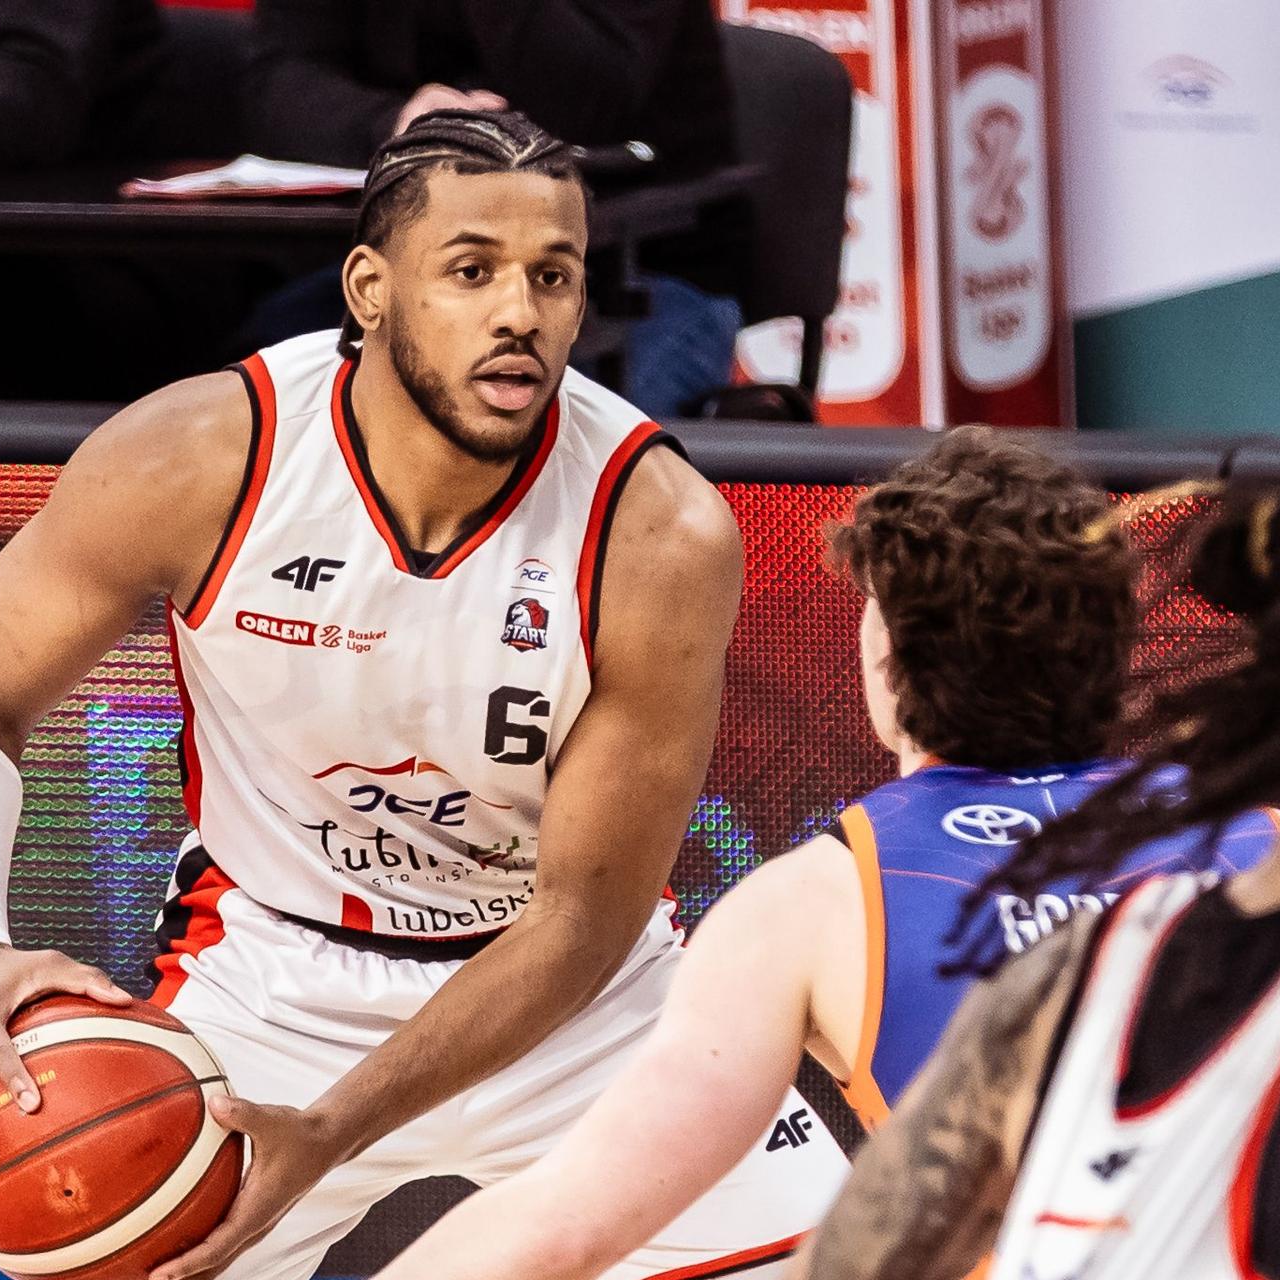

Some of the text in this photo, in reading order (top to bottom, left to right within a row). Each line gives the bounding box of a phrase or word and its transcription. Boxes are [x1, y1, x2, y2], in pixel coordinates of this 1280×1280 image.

[271, 555, 346, 592] 4F
[520, 567, 549, 582] PGE
[240, 614, 387, 642] ORLEN Basket
[503, 622, 548, 648] START
[346, 641, 372, 654] Liga
[483, 685, 551, 766] 6
[765, 1108, 813, 1152] 4F
